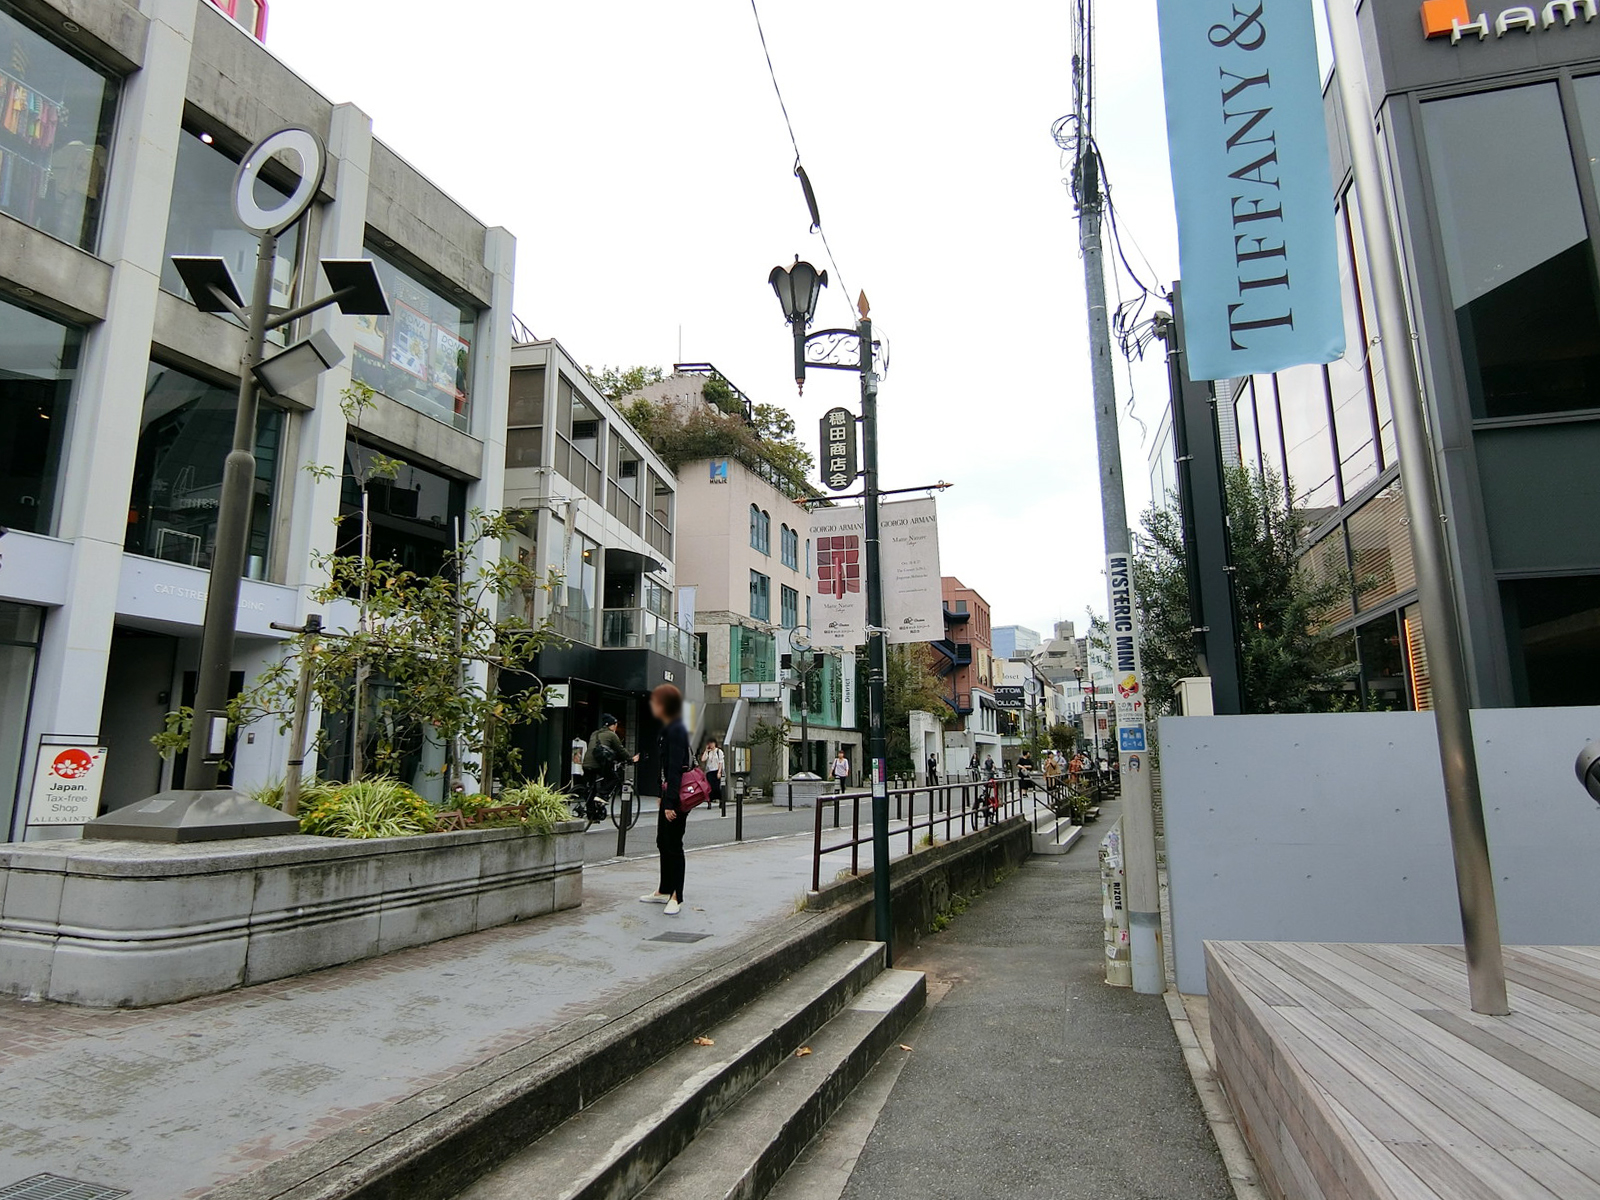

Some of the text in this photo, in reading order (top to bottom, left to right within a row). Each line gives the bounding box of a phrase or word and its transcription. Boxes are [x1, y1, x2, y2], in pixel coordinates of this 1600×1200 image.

[1207, 0, 1294, 351] TIFFANY &
[828, 411, 848, 487] 穏田商店会
[809, 523, 864, 533] GIORGIO ARMANI
[881, 515, 937, 528] GIORGIO ARMANI
[153, 583, 176, 595] CAT
[177, 587, 208, 601] STREE
[1110, 558, 1136, 672] HYSTERIC MINI
[46, 794, 88, 802] Tax-free
[51, 803, 79, 813] Shop
[33, 815, 94, 823] ALLSAINTS
